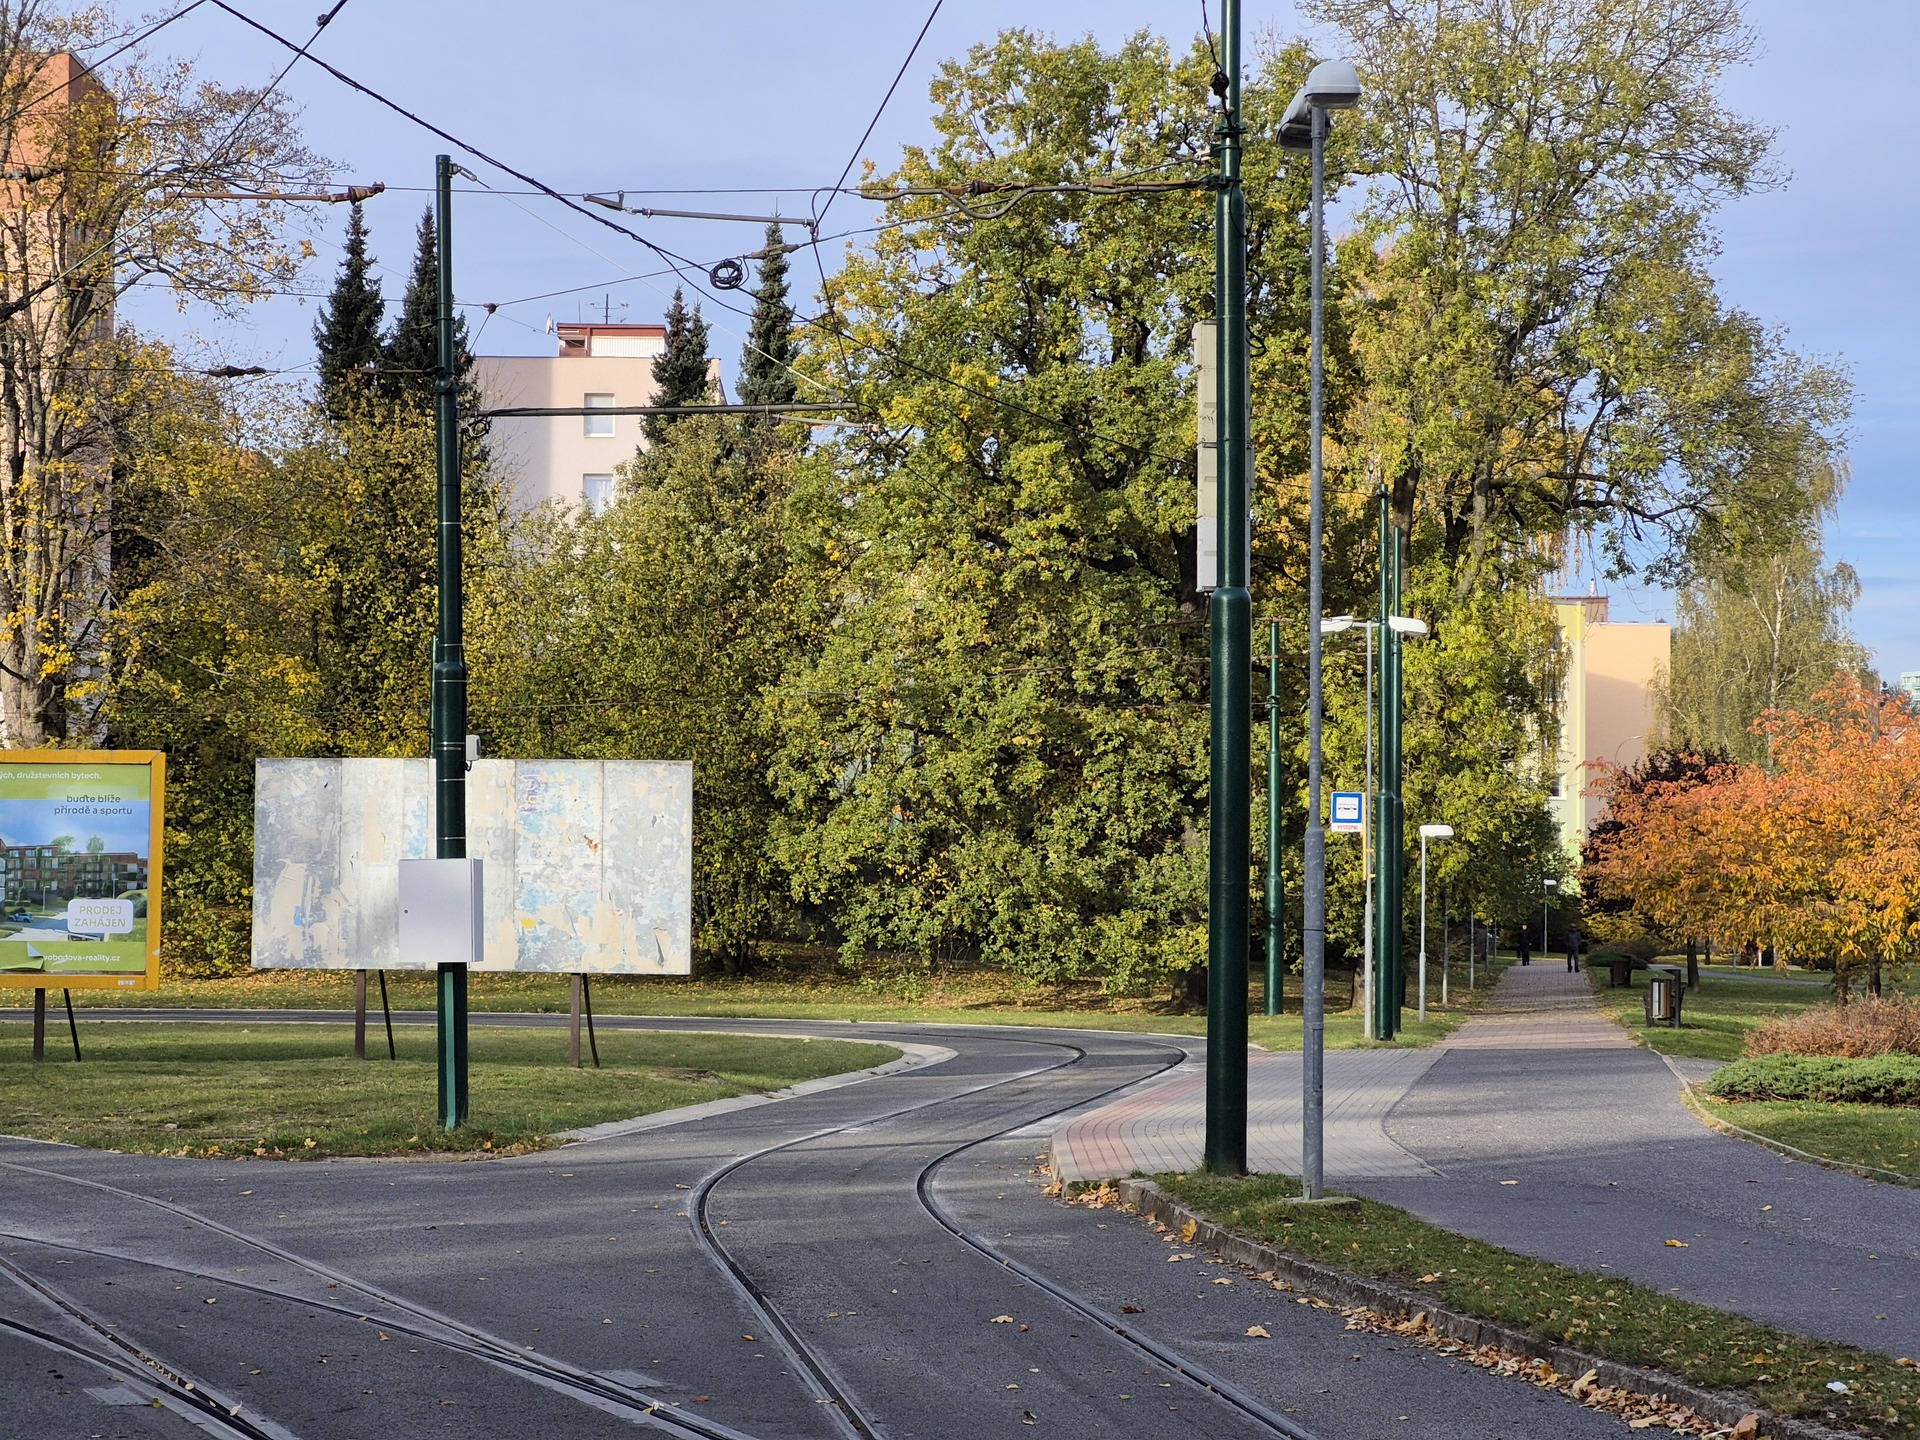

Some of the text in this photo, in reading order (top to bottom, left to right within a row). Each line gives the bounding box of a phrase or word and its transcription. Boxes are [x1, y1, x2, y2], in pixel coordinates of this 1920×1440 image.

[17, 770, 69, 779] družstevních
[71, 771, 102, 781] bytech.
[66, 794, 121, 803] buďte blíže
[54, 805, 91, 815] přírodě
[100, 807, 133, 816] sportu
[79, 905, 122, 915] PRODEJ
[74, 916, 126, 927] ZAHÁJEN
